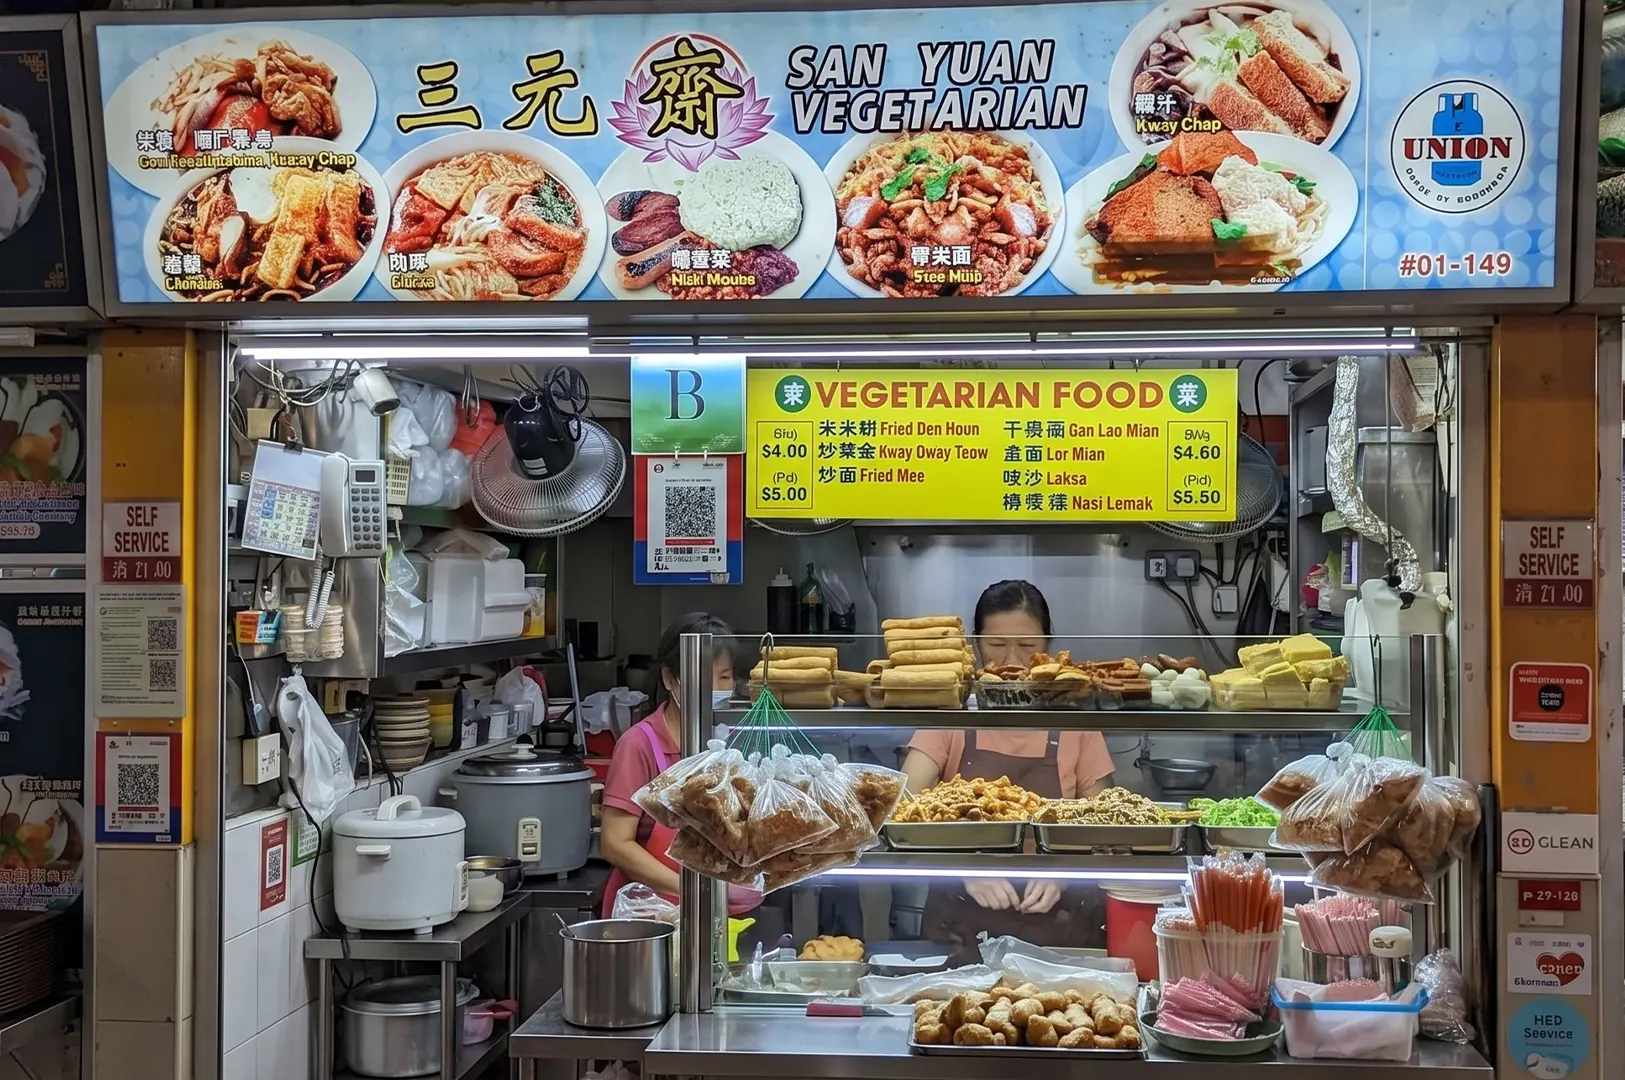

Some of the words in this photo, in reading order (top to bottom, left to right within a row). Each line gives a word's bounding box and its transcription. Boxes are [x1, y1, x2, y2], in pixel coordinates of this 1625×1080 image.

[787, 43, 886, 87] SAN
[920, 40, 1055, 85] YUAN
[793, 86, 1087, 132] VEGETARIAN
[1181, 117, 1222, 133] Chap
[1402, 137, 1513, 160] UNION
[1400, 254, 1512, 276] #01-149
[664, 368, 707, 421] B
[815, 381, 1040, 409] VEGETARIAN
[1054, 381, 1164, 409] FOOD
[880, 421, 913, 436] Fried
[917, 421, 942, 436] Den
[946, 421, 980, 436] Houn
[1069, 423, 1095, 438] Gan
[1098, 423, 1124, 438] Lao
[1126, 423, 1159, 438] Mian
[762, 443, 807, 459] $4.00
[879, 444, 912, 462] Kway
[954, 444, 989, 460] Teow
[1047, 446, 1069, 461] Lor
[1072, 446, 1105, 461] Mian
[1173, 445, 1221, 460] $4.60
[860, 468, 893, 483] Fried
[897, 468, 925, 483] Mee
[1047, 471, 1087, 486] Laksa
[761, 486, 807, 502] $5.00
[1173, 490, 1221, 505] $5.50
[1072, 495, 1103, 511] Nasi
[1107, 495, 1153, 511] Lemak
[127, 506, 158, 527] SELF
[114, 532, 169, 553] SERVICE
[1530, 526, 1565, 549] SELF
[1519, 553, 1579, 576] SERVICE
[1534, 1015, 1562, 1026] HED
